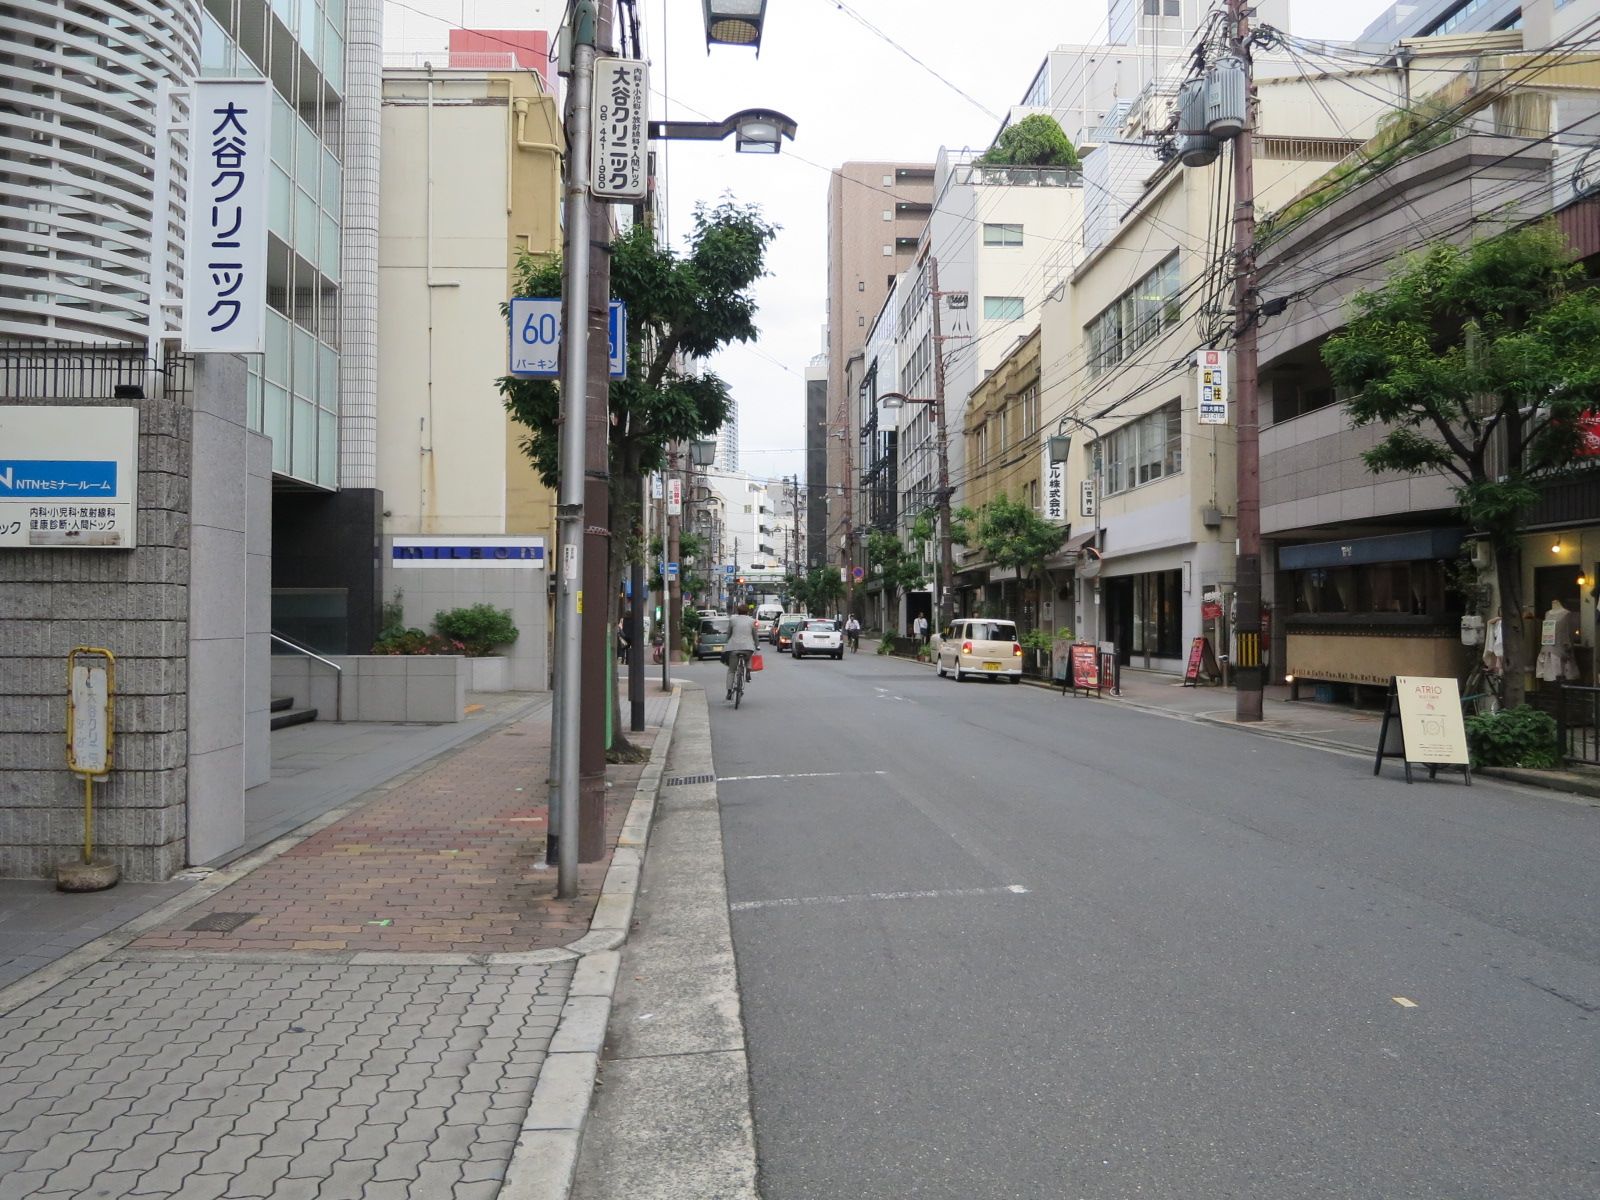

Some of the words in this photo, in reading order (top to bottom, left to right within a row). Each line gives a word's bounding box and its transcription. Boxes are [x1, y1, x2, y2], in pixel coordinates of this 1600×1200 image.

[608, 67, 630, 190] 大谷クリニック
[208, 101, 248, 333] 大谷クリニック
[523, 313, 561, 344] 60
[16, 480, 111, 490] NTNセミナールーム
[29, 507, 116, 518] 内科・小児科・放射線科
[29, 519, 116, 530] 健康診断・人間ドック
[1415, 685, 1442, 694] ATRIO
